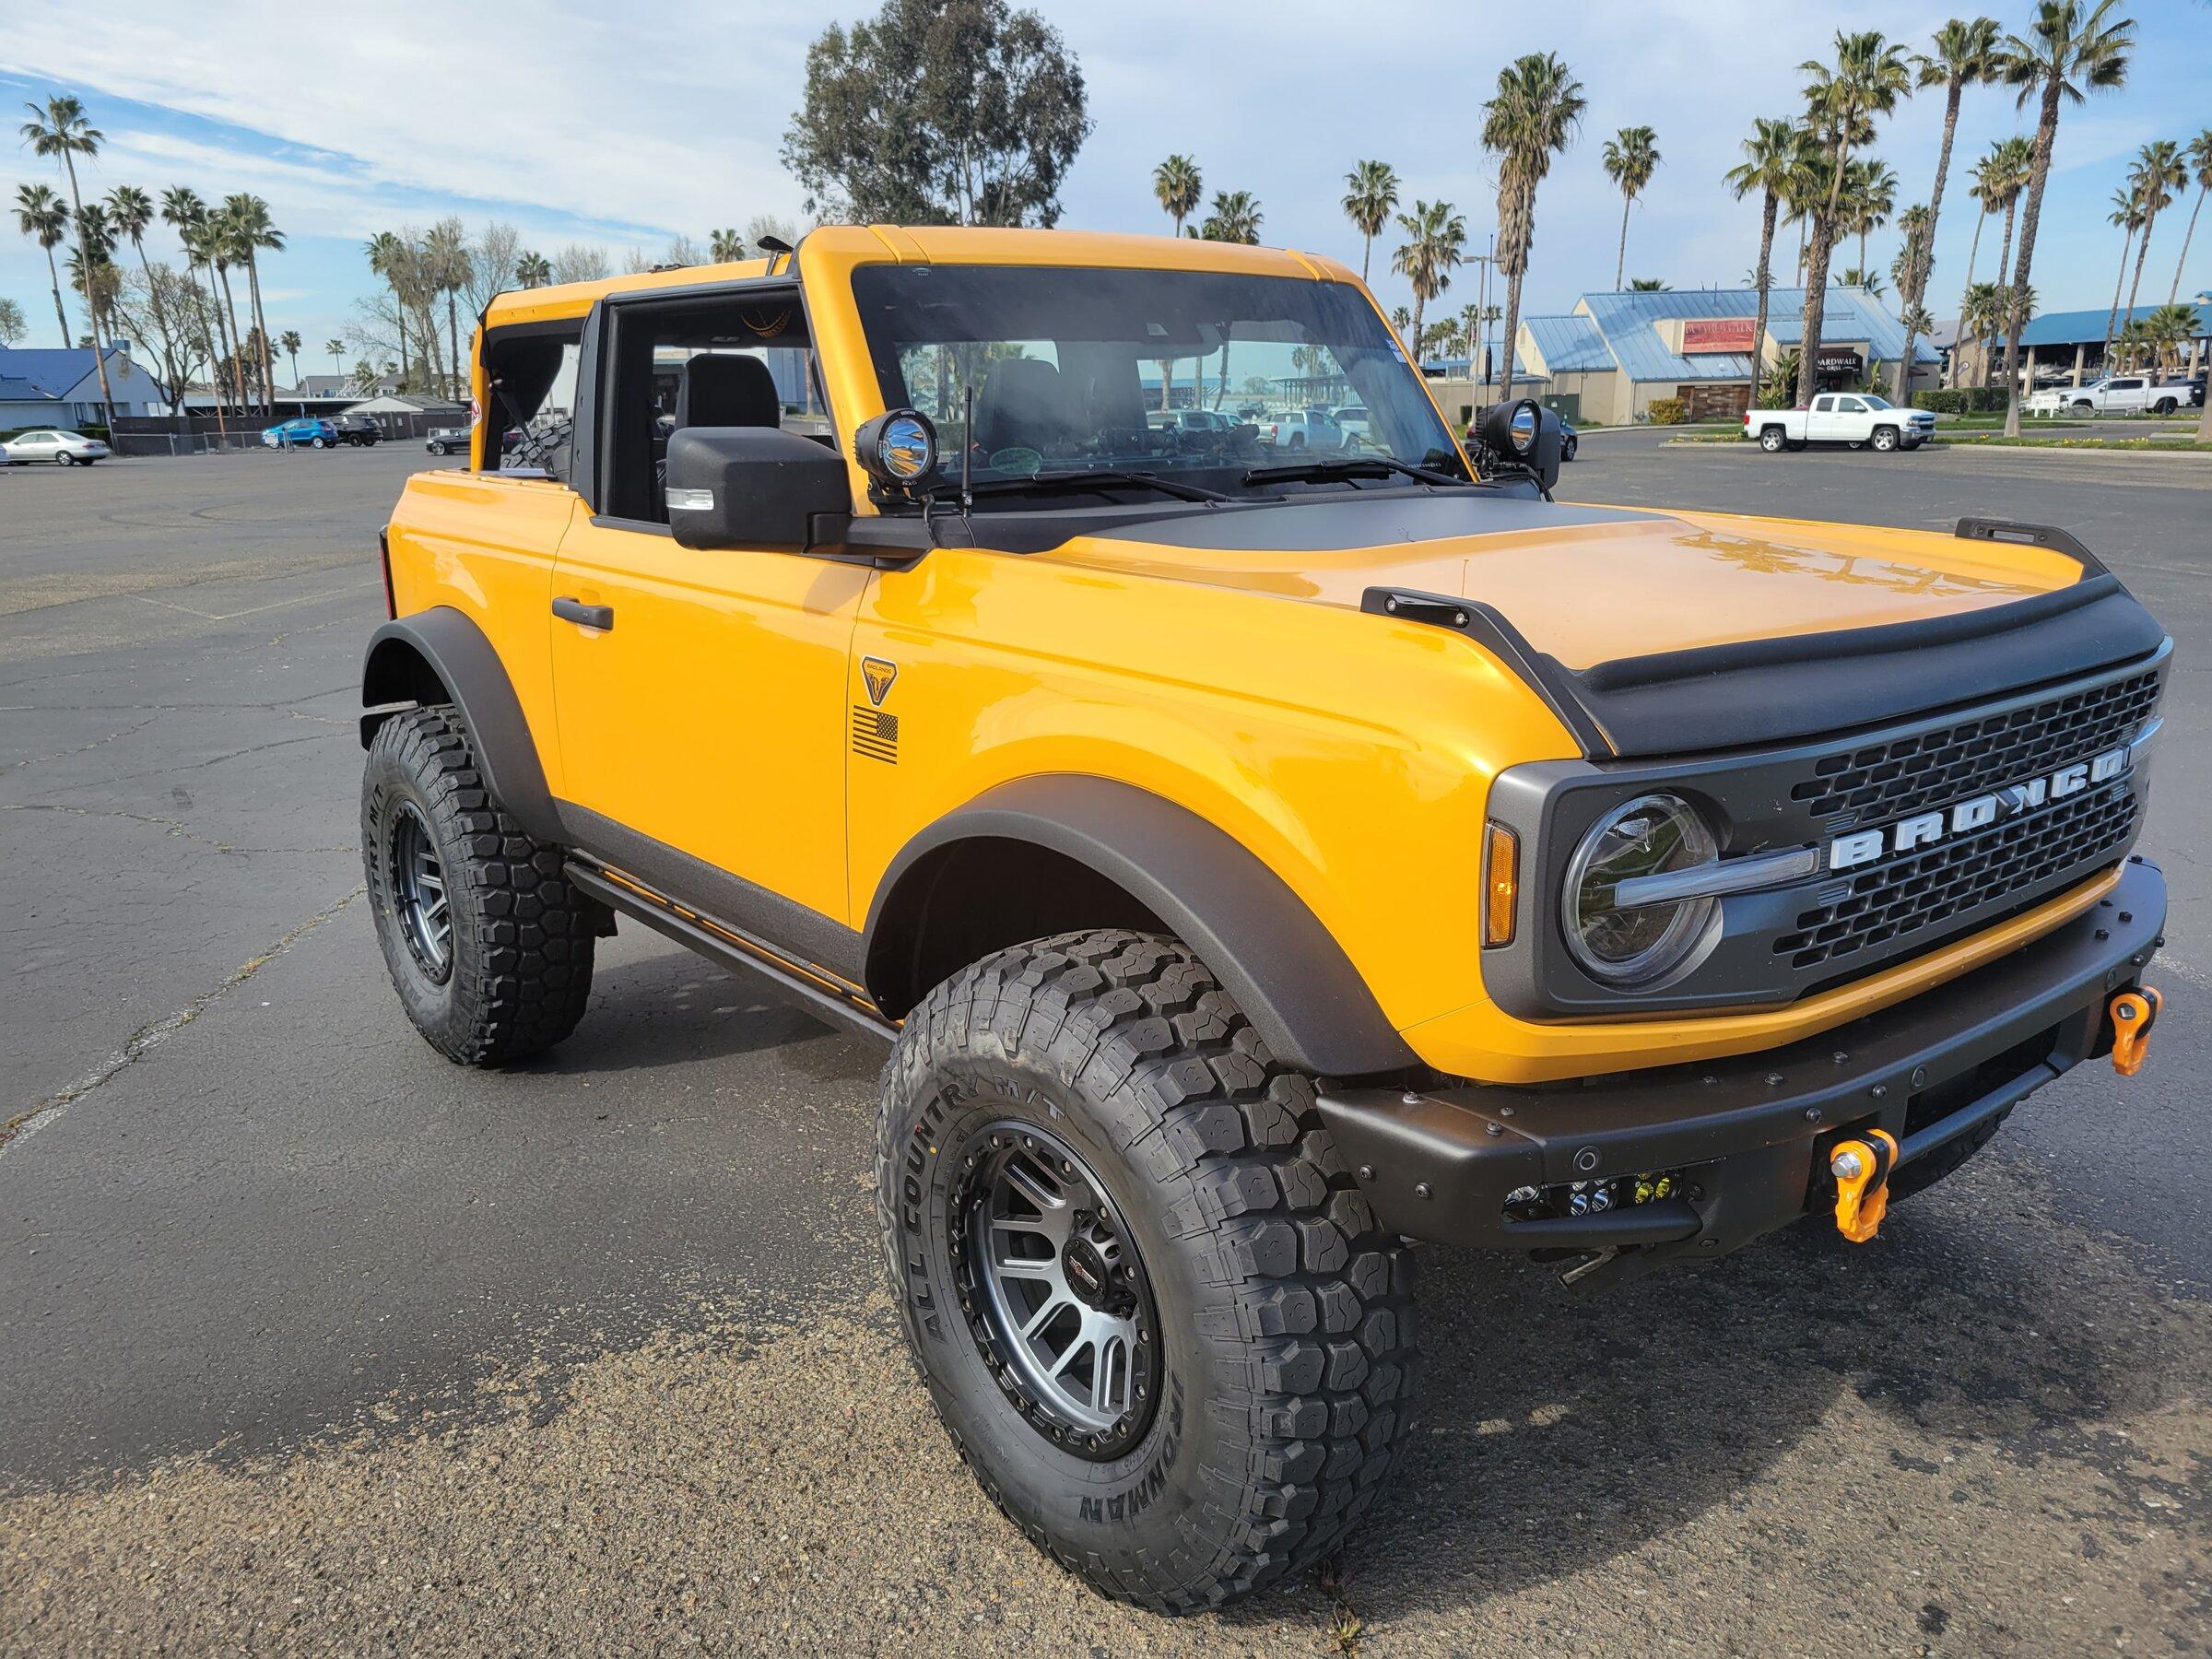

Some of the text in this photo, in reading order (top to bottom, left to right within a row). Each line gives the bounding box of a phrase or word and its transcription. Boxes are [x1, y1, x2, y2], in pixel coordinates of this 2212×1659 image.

[1818, 357, 1857, 366] ARDWALK
[1829, 748, 2124, 869] BRONCO
[903, 1073, 1069, 1344] ALL COUNTRY M/T
[1078, 1369, 1185, 1524] IRONMAN
